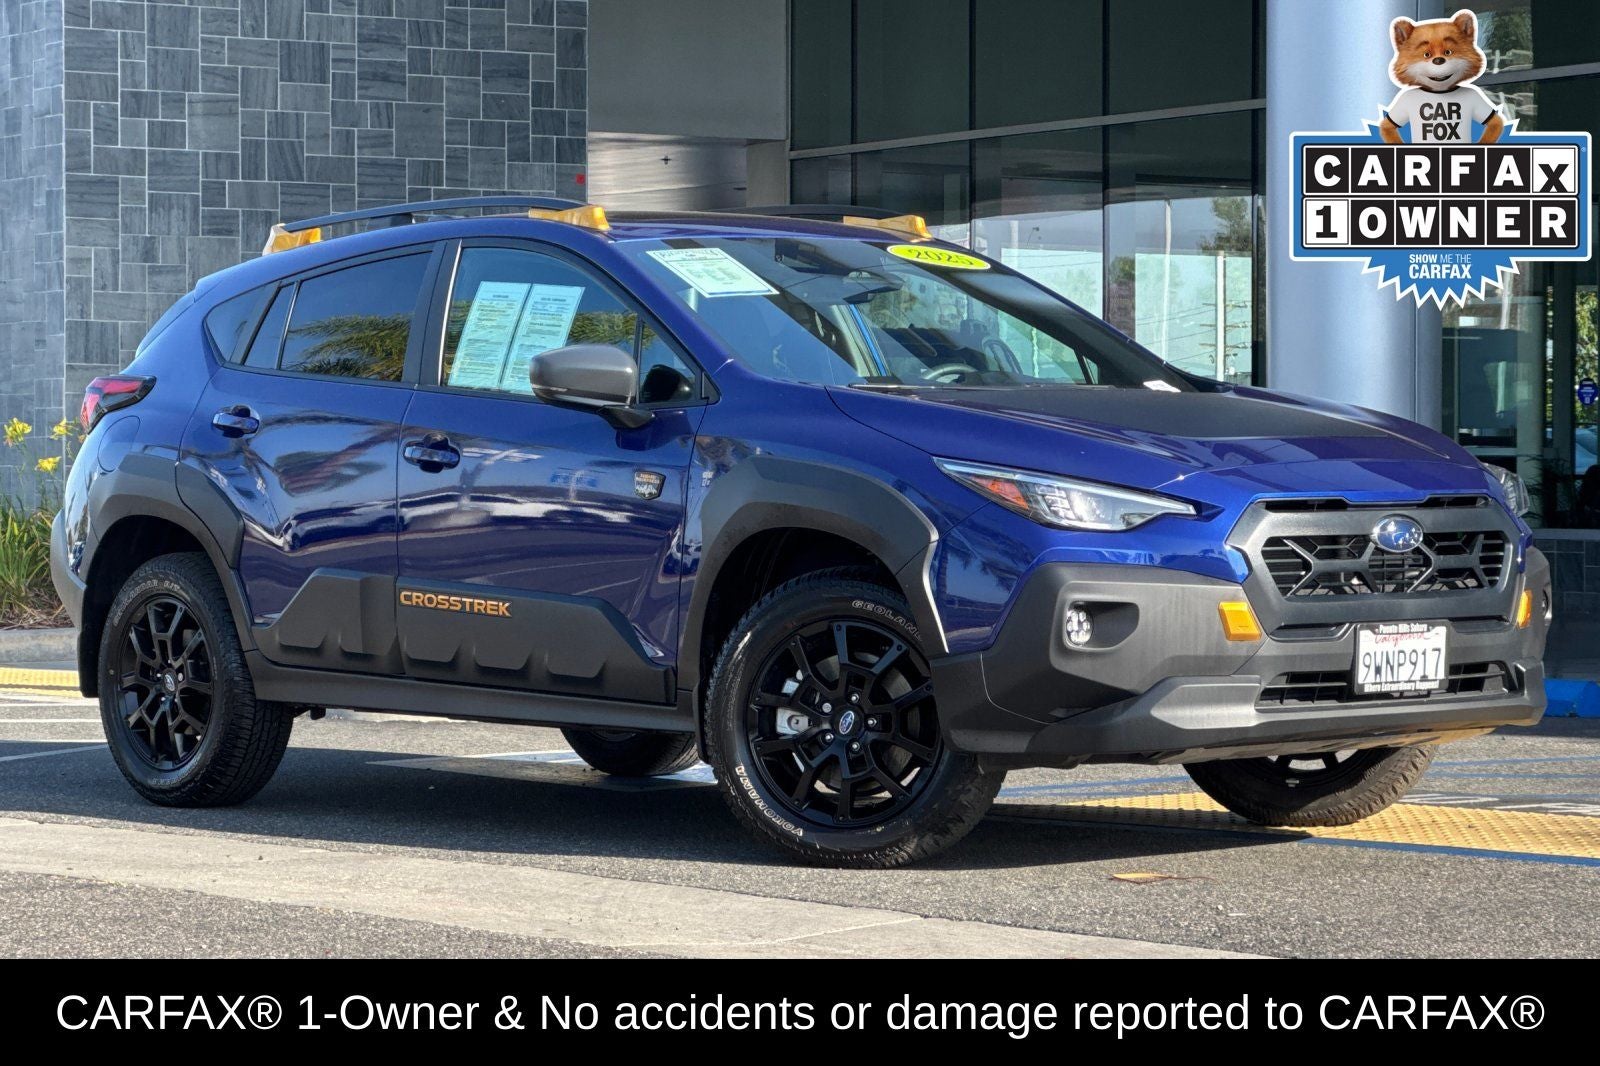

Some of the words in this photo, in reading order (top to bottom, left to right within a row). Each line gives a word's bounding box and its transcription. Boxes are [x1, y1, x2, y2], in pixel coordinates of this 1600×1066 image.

[908, 248, 975, 266] 2025
[400, 591, 513, 617] CROSSTREK
[1362, 648, 1442, 682] 9WNP917
[735, 764, 804, 837] YOKOHAMA
